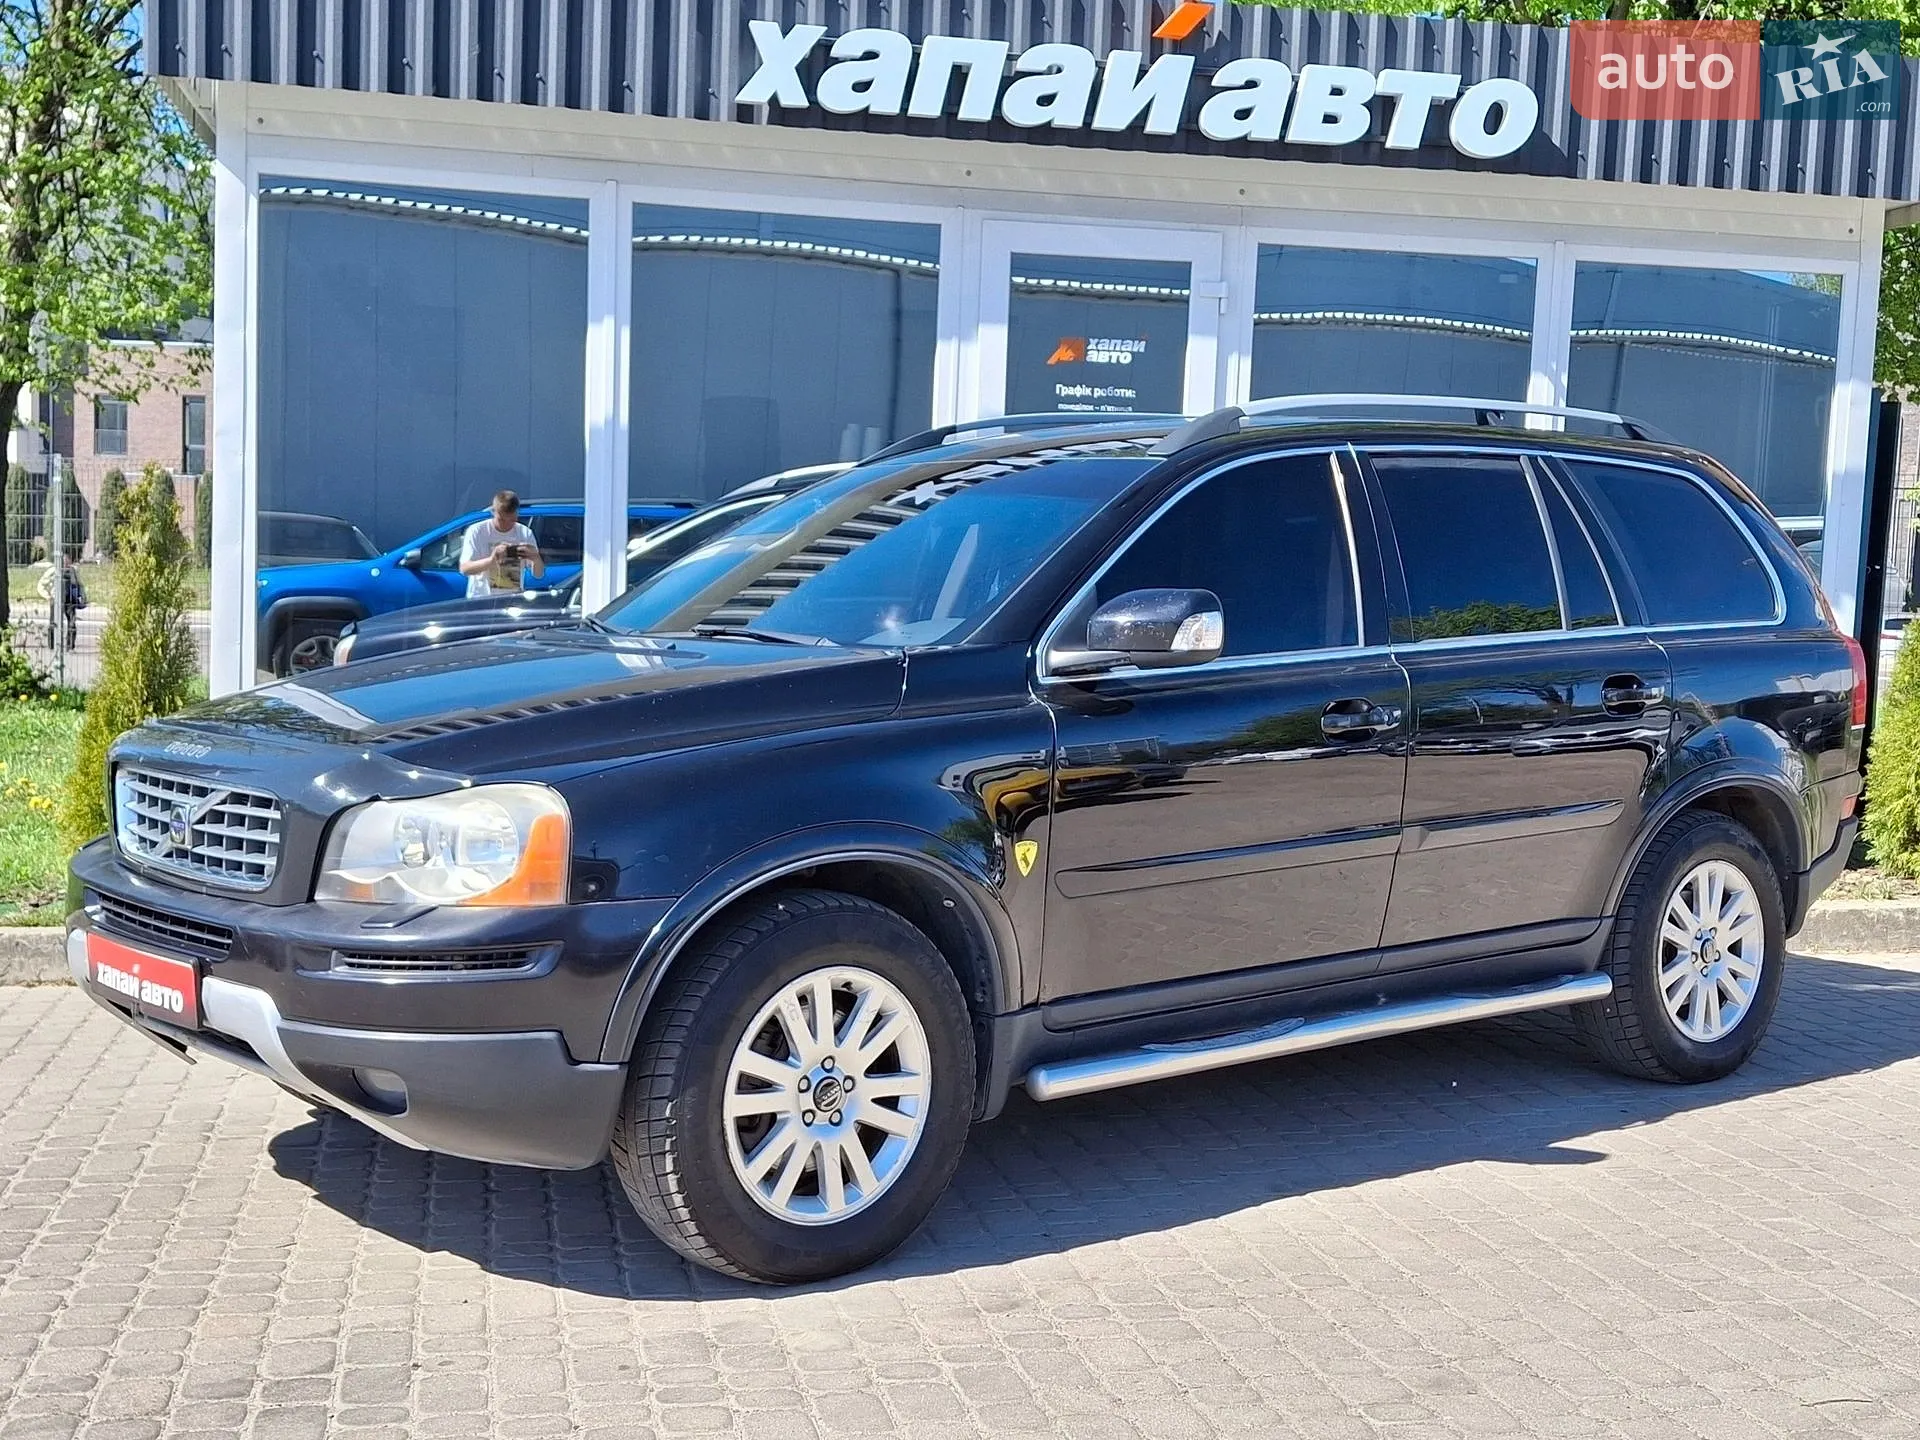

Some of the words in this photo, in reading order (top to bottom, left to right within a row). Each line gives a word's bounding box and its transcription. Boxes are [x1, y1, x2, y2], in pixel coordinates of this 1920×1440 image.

[734, 1, 1211, 134] хапай
[1198, 57, 1540, 159] авто
[1085, 350, 1133, 364] авто
[1055, 383, 1092, 397] Графік
[1093, 385, 1137, 399] роботи:
[96, 962, 140, 999] хапай
[140, 980, 184, 1014] авто
